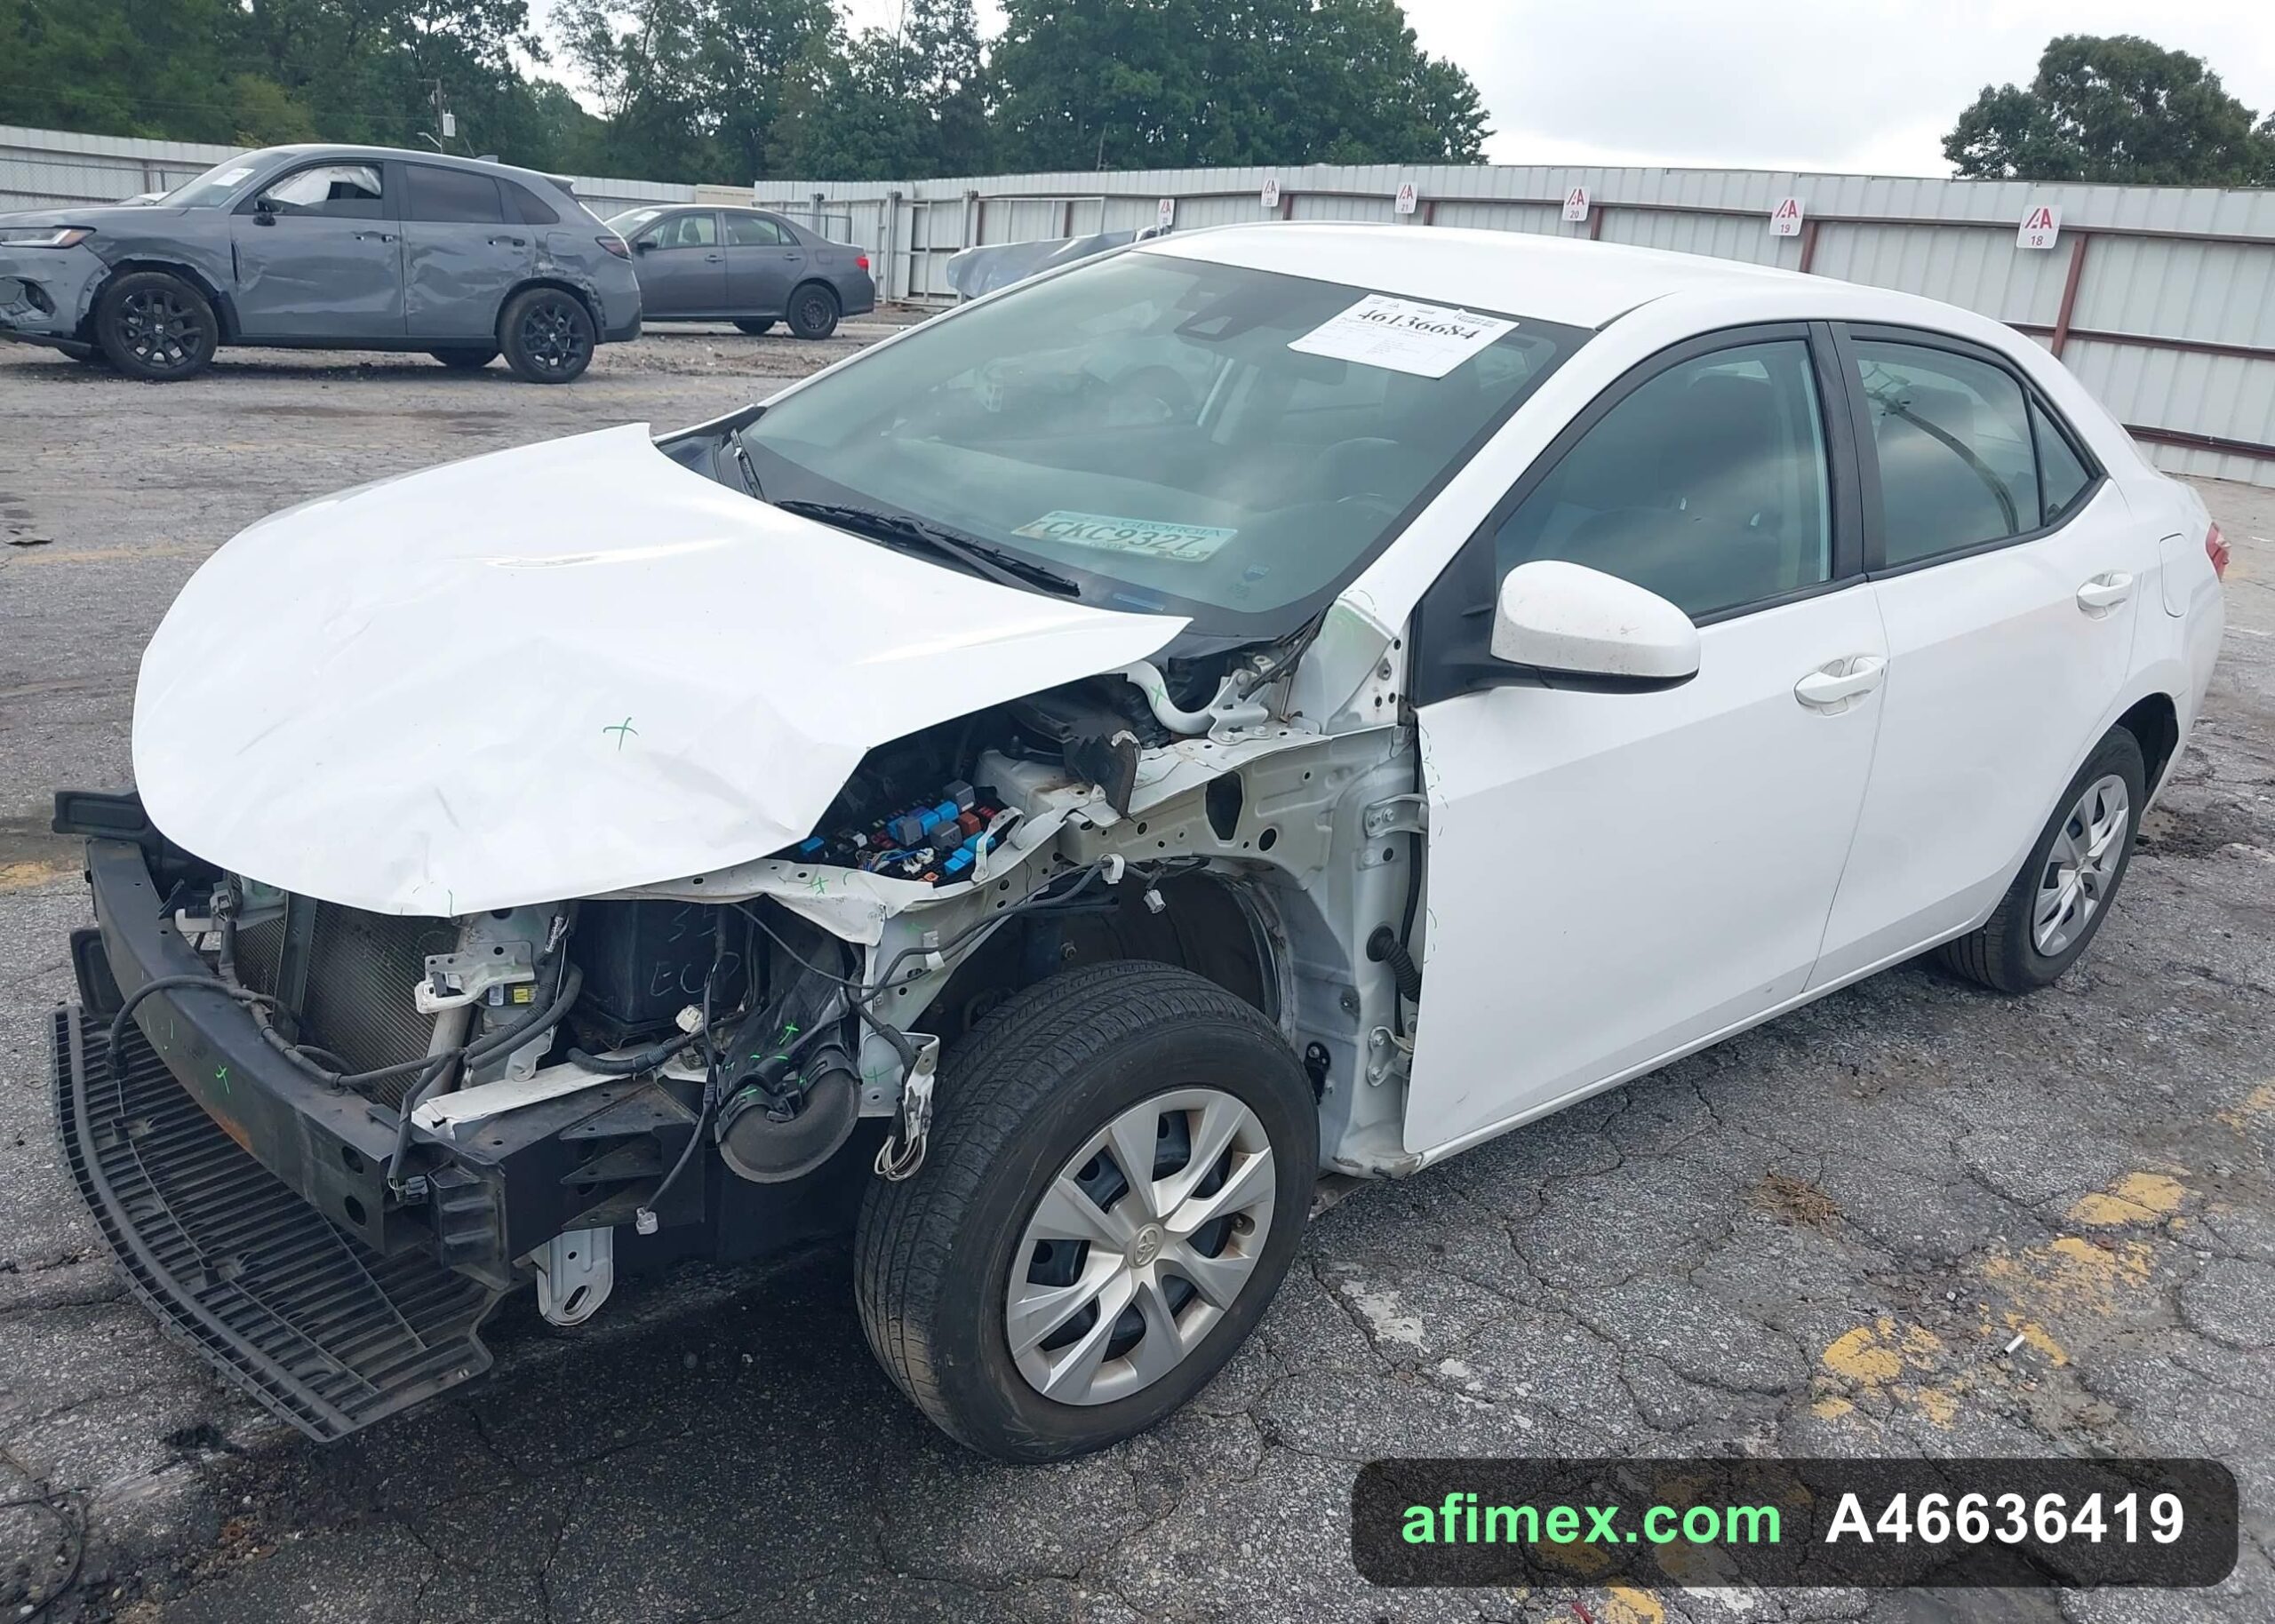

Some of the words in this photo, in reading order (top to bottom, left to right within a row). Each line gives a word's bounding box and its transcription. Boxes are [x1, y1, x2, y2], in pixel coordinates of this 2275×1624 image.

[1569, 210, 1579, 219] 20
[1780, 224, 1791, 234] 19
[2031, 235, 2044, 246] 18
[1357, 309, 1481, 339] 46136684
[1121, 521, 1220, 537] GEORGIA
[1042, 521, 1205, 552] CKC9327
